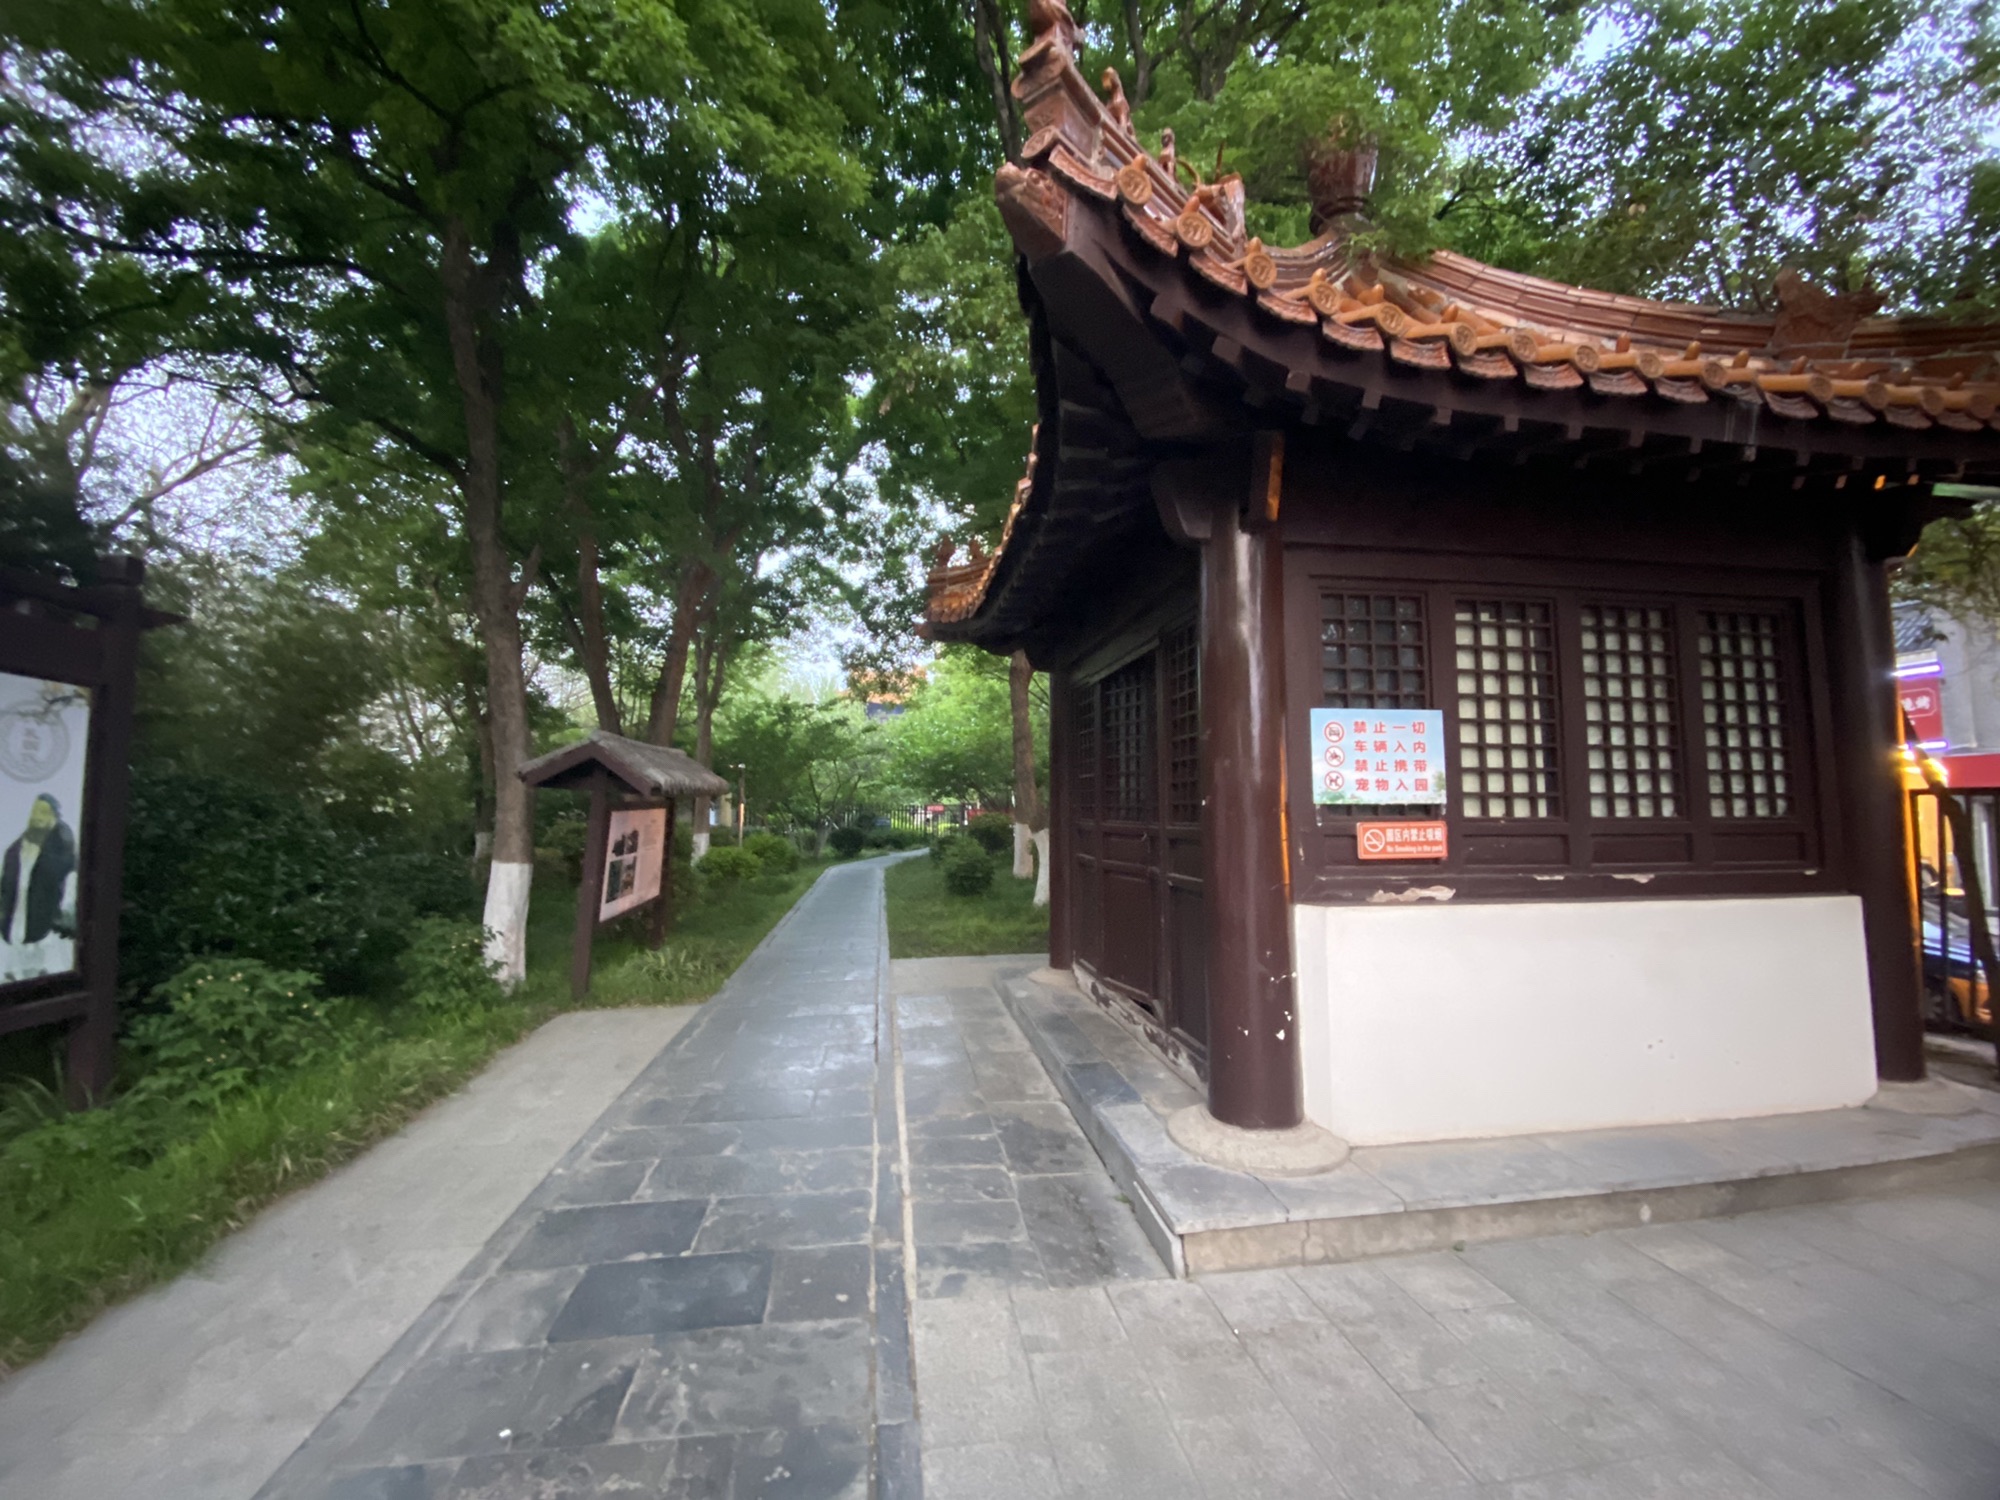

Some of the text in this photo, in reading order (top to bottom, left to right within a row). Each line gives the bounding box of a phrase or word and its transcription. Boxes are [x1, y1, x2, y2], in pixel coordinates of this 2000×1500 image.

[1353, 721, 1425, 734] 禁止一切
[1354, 740, 1426, 753] 车辆入内
[1355, 759, 1427, 772] 禁止携带
[1355, 778, 1428, 791] 宠物入园
